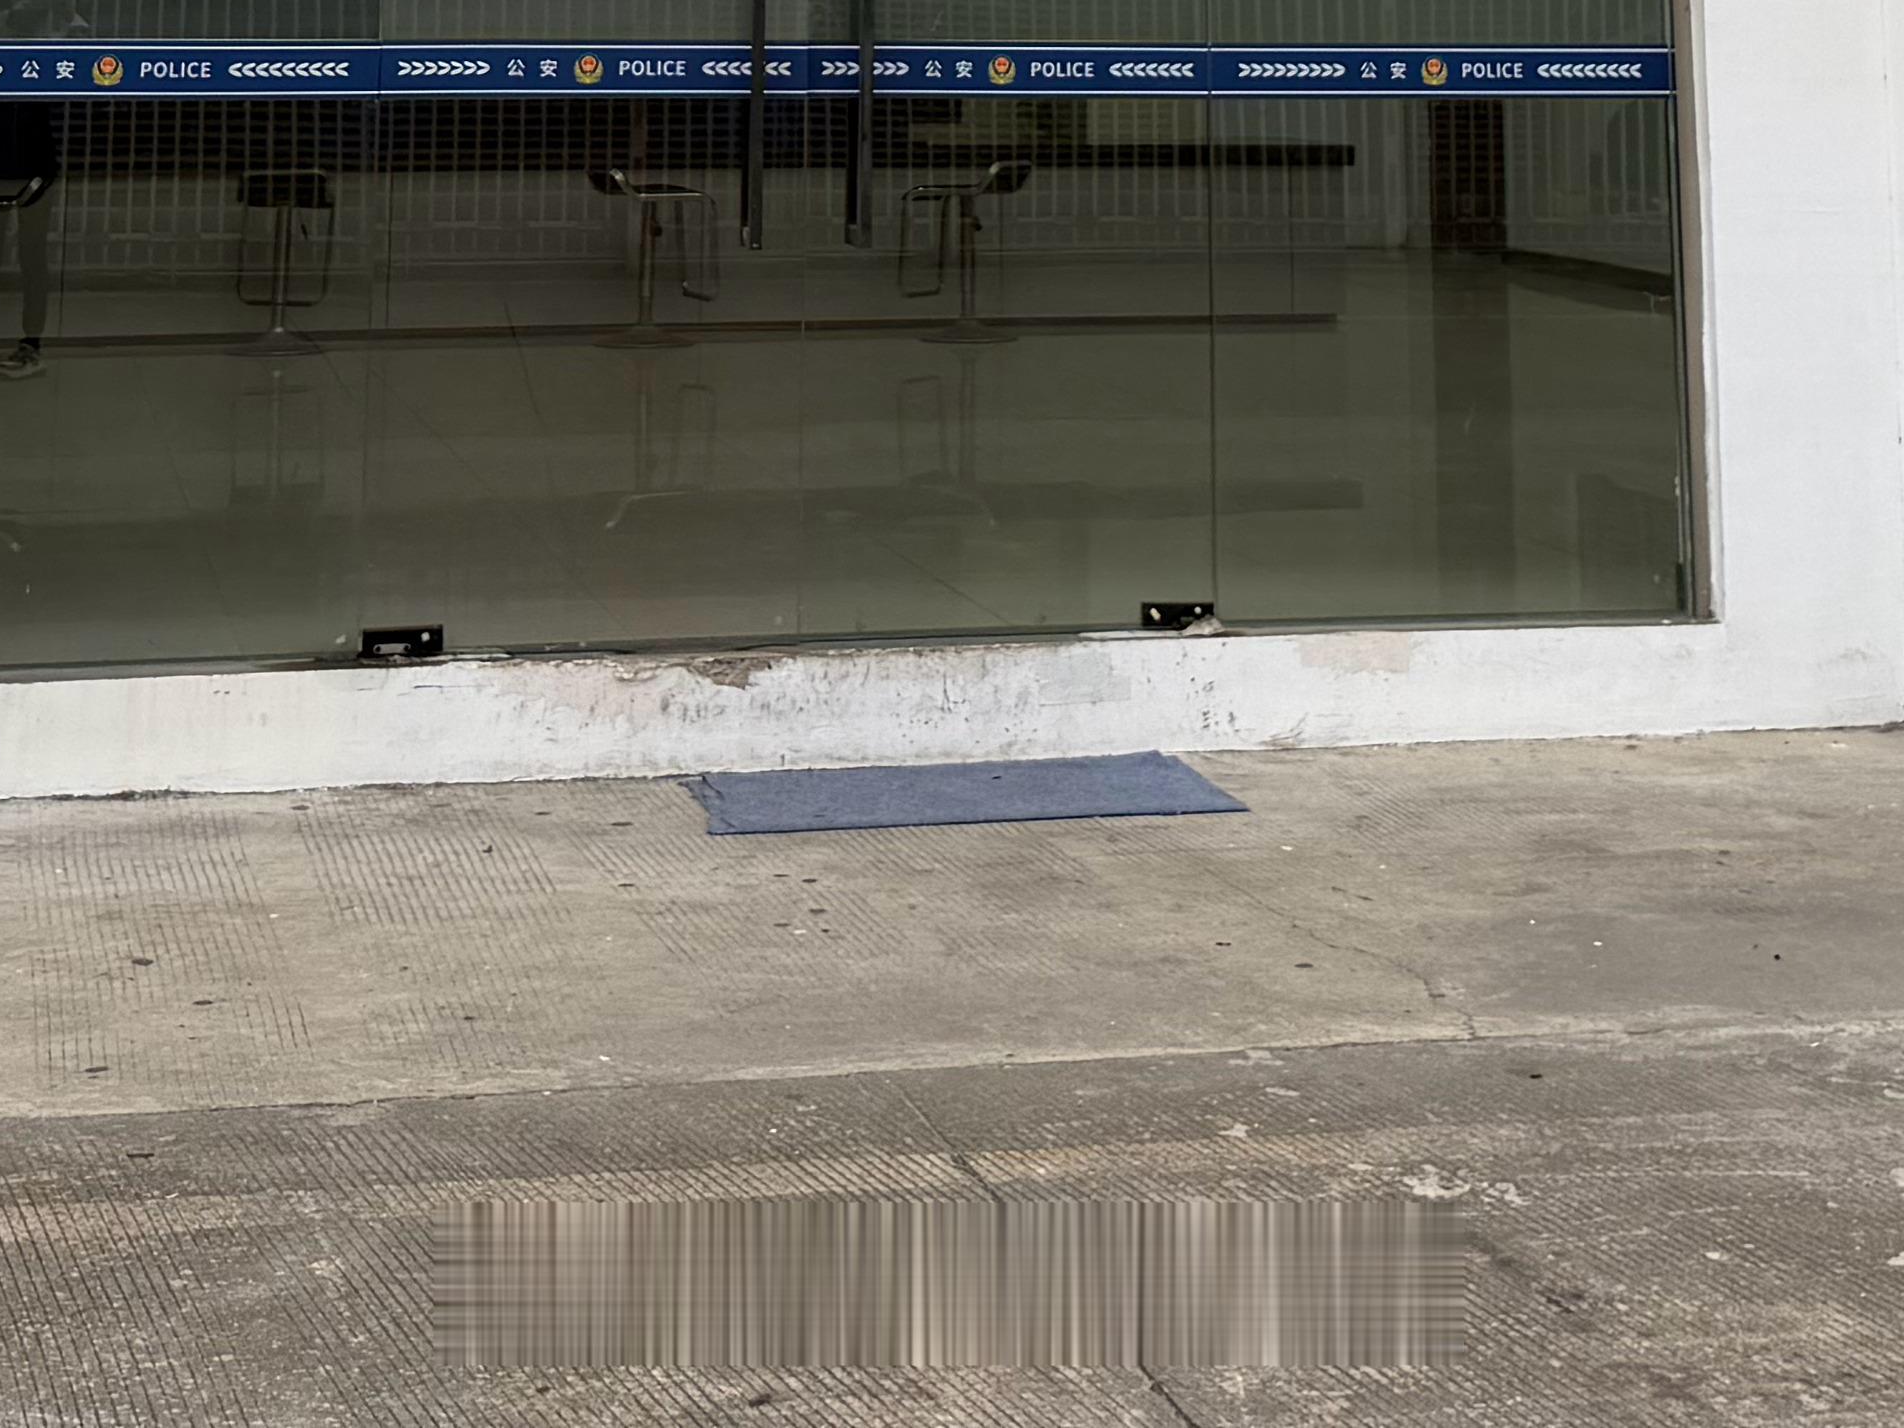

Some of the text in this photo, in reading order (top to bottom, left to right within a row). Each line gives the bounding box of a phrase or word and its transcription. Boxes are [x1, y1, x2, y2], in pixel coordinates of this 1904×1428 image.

[21, 59, 212, 82] 公安 POLICE
[507, 59, 686, 82] 公安 POLICE
[924, 59, 1094, 82] 公安 POLICE
[1360, 59, 1524, 82] 公安 POLICE
